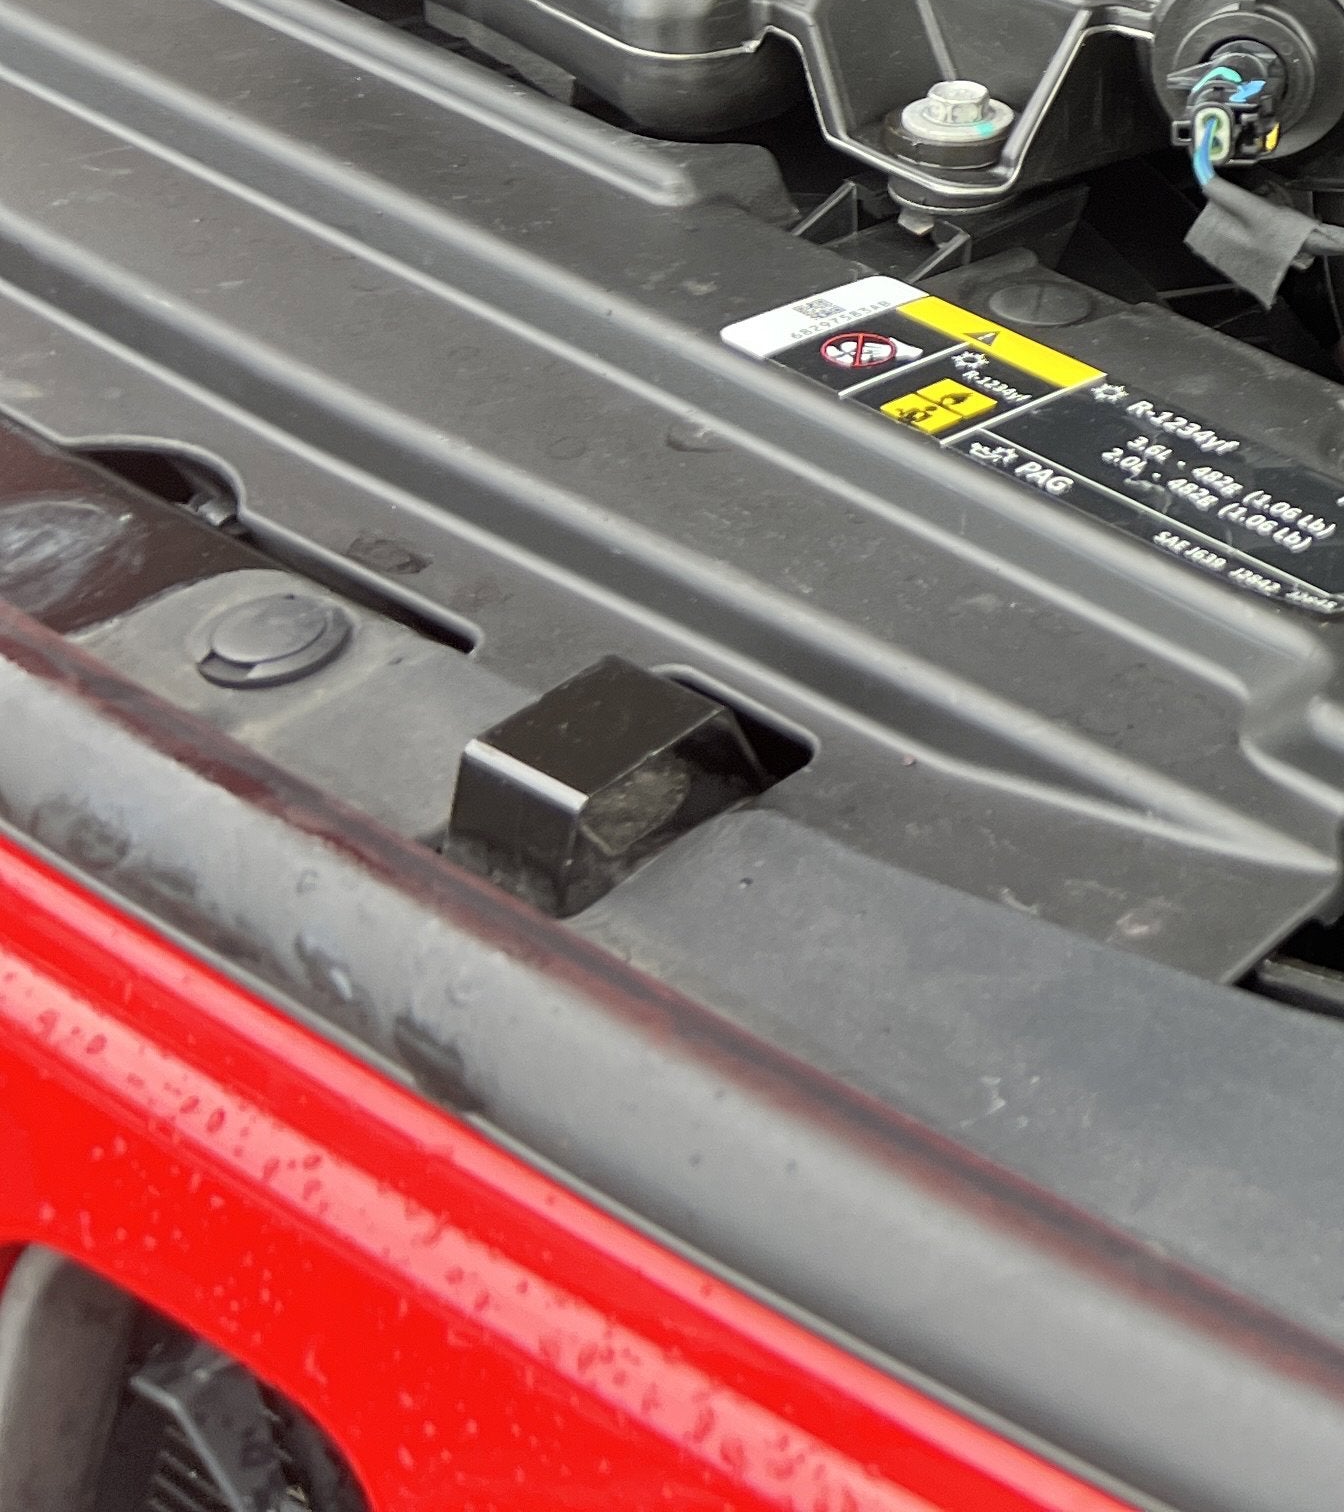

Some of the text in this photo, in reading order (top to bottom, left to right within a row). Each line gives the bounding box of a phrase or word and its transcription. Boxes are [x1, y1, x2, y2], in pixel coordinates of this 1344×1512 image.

[962, 370, 1033, 404] R-1234yf
[1126, 399, 1240, 455] R-1234yf
[1014, 461, 1075, 496] PAG
[1101, 447, 1313, 554] 2.0L 482g (1.06 Lb)
[1126, 435, 1337, 539] 3.6L 482g (1.06 Lb)
[1152, 530, 1191, 554] SAE
[1183, 546, 1227, 571] J639
